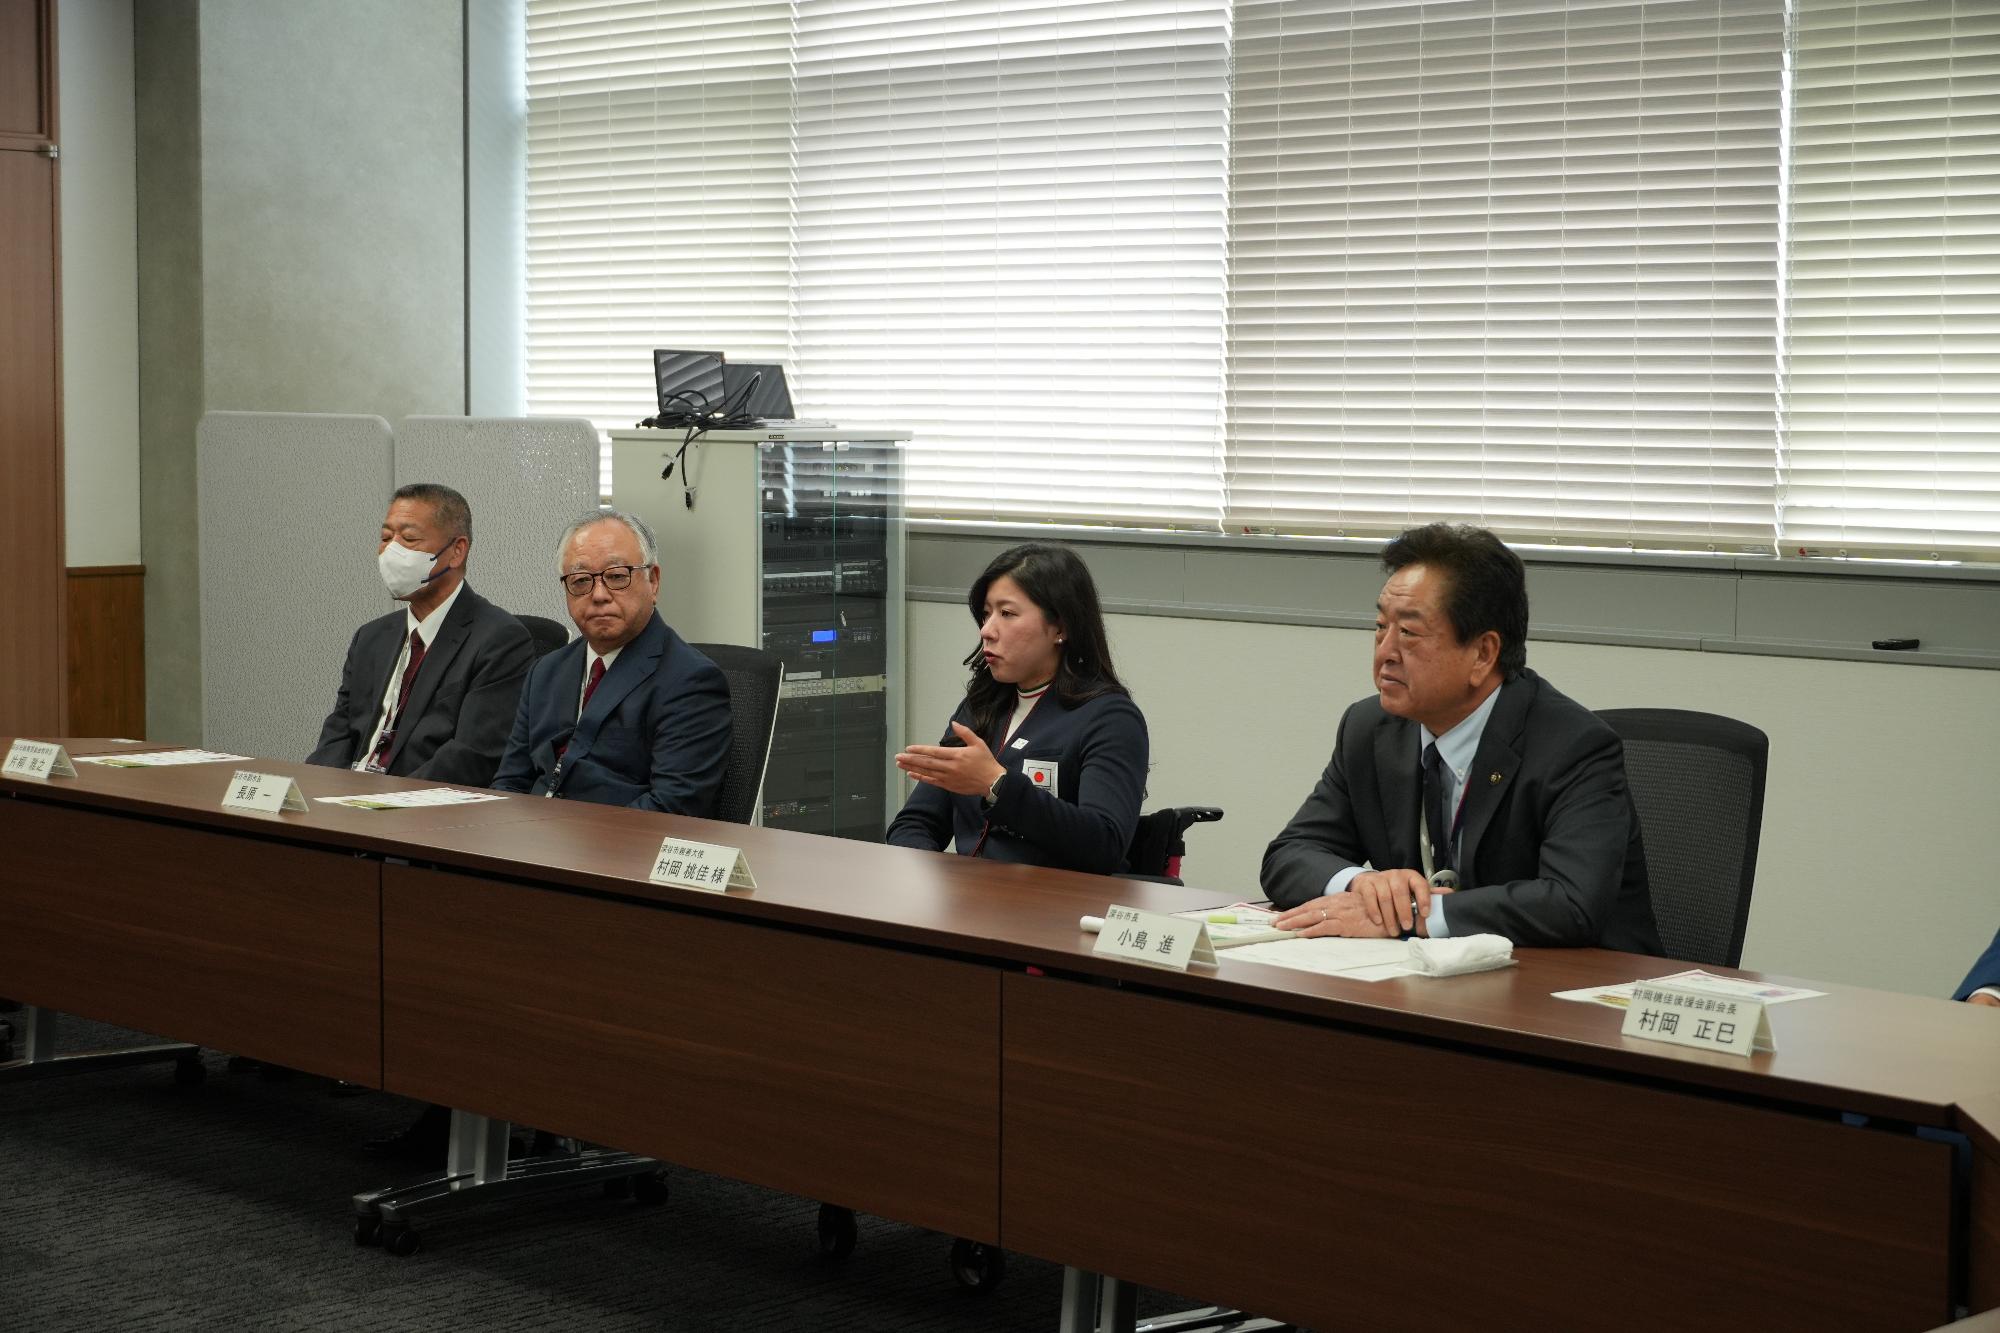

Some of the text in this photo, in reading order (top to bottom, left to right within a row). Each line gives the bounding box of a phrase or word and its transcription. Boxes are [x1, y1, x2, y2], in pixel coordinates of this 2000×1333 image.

[236, 785, 259, 801] 長原
[656, 858, 726, 884] 村岡 桃佳 様
[1108, 908, 1140, 922] 深谷市長
[1117, 927, 1176, 955] 小島 進
[1638, 1007, 1681, 1036] 村岡
